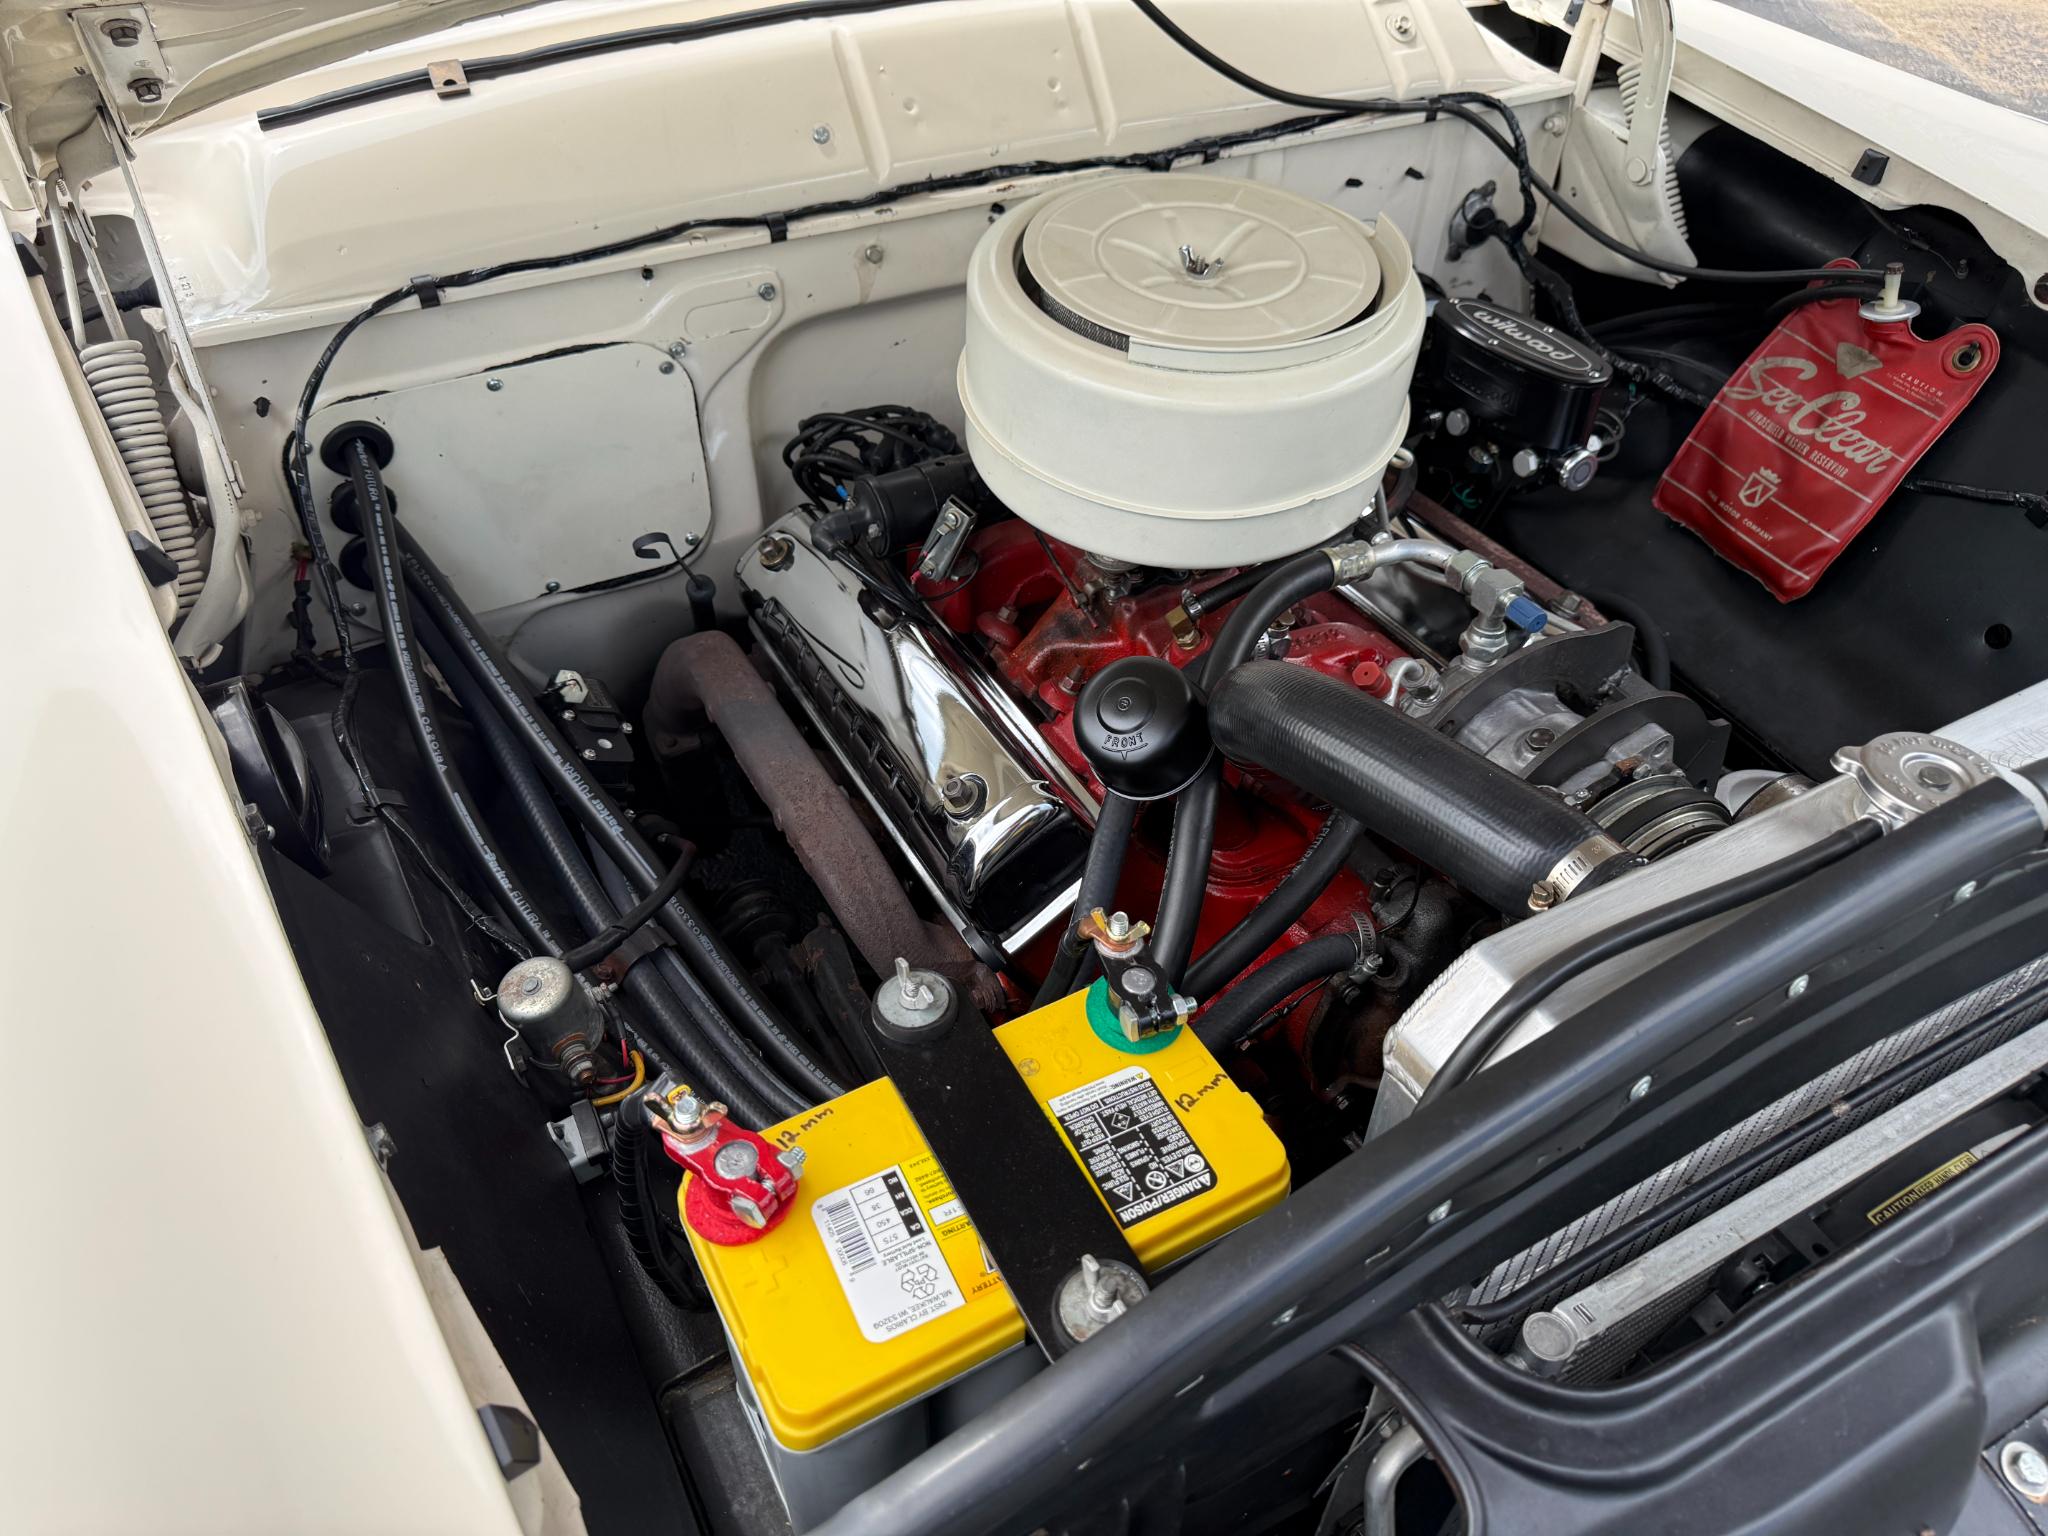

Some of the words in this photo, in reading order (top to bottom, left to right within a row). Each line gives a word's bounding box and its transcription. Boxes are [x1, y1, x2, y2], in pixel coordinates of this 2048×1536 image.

[1472, 310, 1576, 361] wilwood
[1810, 448, 1849, 478] RESERVOIR
[361, 467, 380, 501] FUTURA
[1718, 500, 1741, 521] MOTOR
[1743, 517, 1774, 542] COMPANY
[1104, 731, 1145, 748] FRONT
[558, 761, 595, 800] FUTURA
[587, 796, 624, 835] Parker
[507, 888, 546, 930] FUTURA
[1175, 1093, 1199, 1113] 12
[1200, 1073, 1229, 1096] mm
[776, 1129, 801, 1149] 12
[801, 1107, 834, 1131] mm
[1118, 1177, 1201, 1223] DANGER/POISON
[1875, 1191, 1920, 1223] CAUTION
[875, 1217, 891, 1228] 450
[881, 1232, 899, 1245] 575
[913, 1277, 926, 1287] Pb
[871, 1313, 898, 1330] 53209
[884, 1313, 918, 1332] CLARIOS
